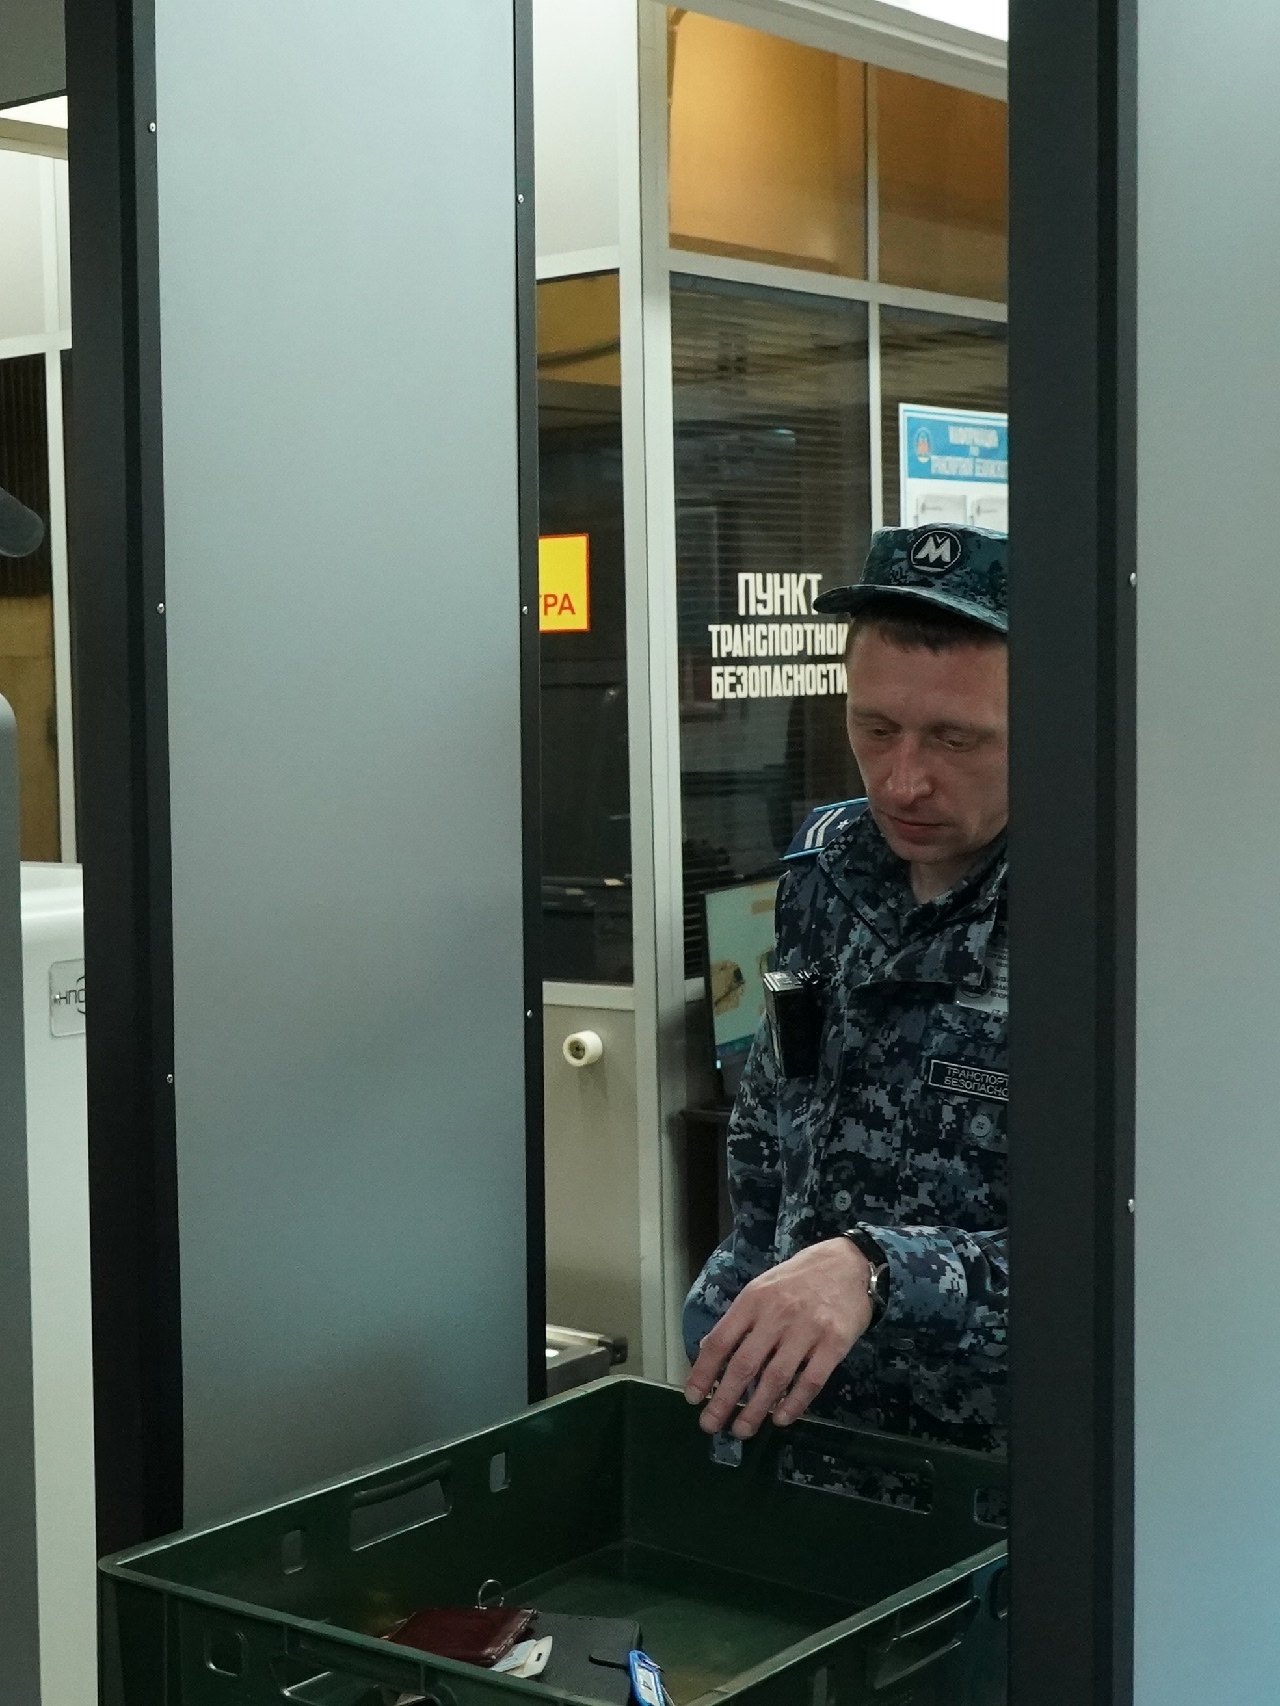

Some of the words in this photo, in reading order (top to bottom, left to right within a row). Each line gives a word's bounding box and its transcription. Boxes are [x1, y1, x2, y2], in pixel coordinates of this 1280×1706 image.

[539, 593, 576, 616] РА
[737, 572, 823, 616] ПУНКТ
[711, 662, 847, 700] БЕЗОПАСНОСТИ
